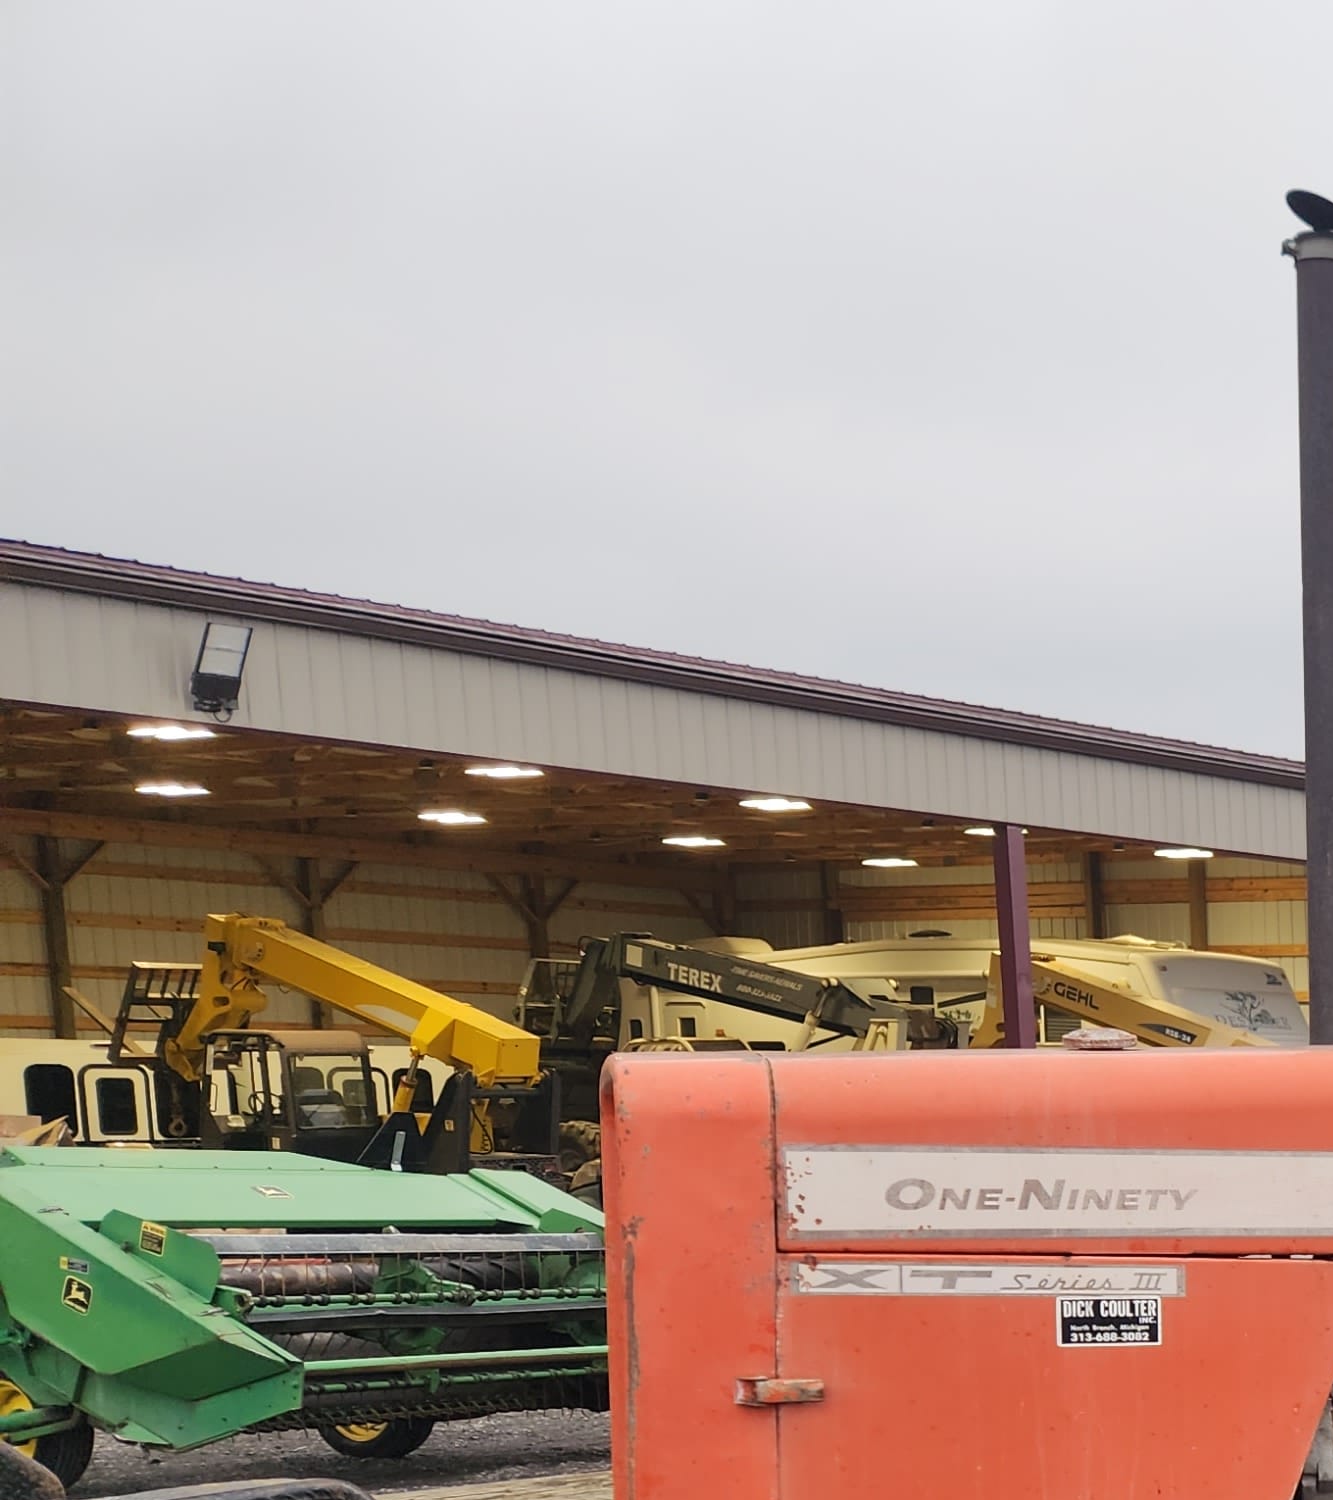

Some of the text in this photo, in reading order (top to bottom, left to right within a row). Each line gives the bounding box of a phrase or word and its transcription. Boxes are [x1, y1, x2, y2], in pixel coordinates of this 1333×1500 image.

[667, 962, 723, 993] TEREX
[1054, 982, 1099, 1010] GEHL
[1000, 1274, 1125, 1291] Series
[1128, 1272, 1167, 1291] III
[1063, 1300, 1157, 1318] DICK COULTER
